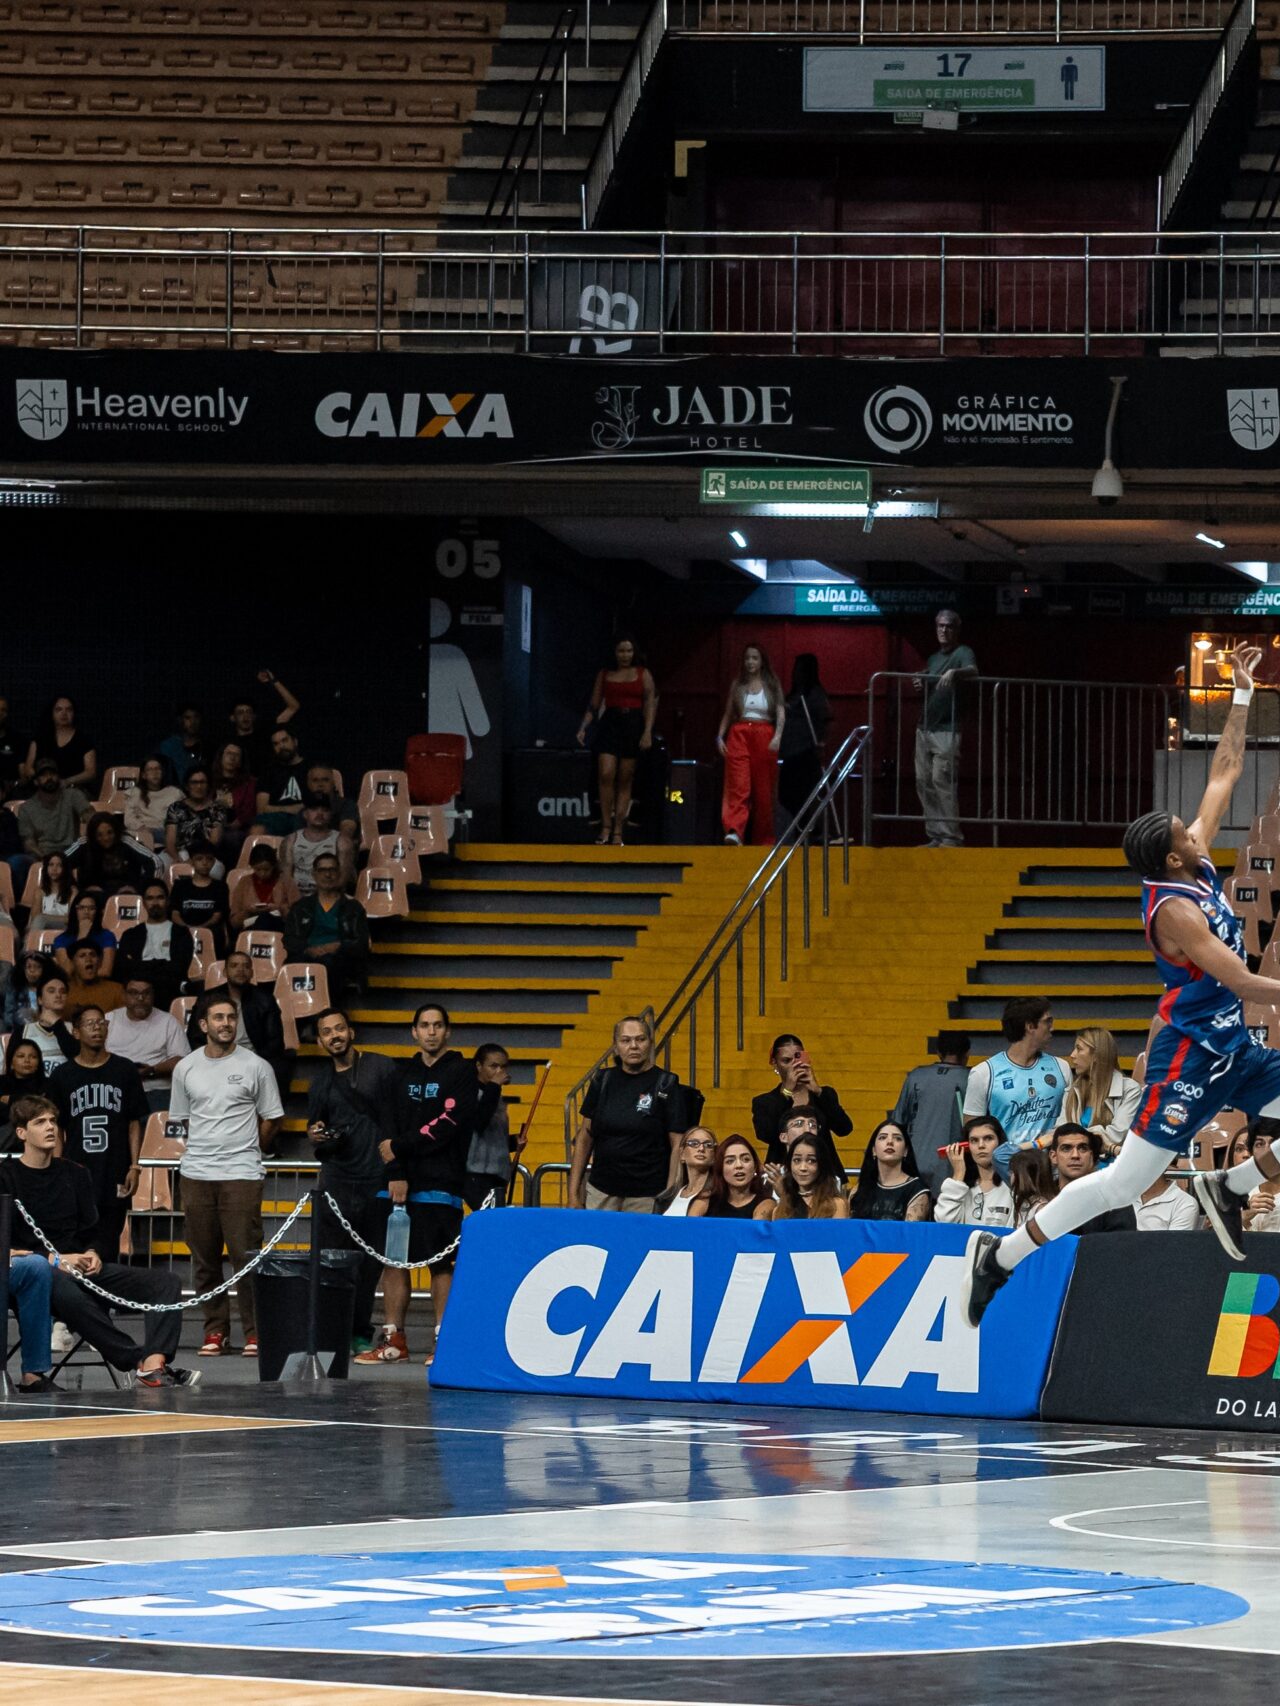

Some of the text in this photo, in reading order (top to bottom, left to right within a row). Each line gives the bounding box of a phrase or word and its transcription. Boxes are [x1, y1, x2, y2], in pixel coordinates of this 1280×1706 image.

[936, 53, 972, 77] 17
[887, 85, 1023, 99] SAÍDA DE EMERGÊNCIA
[76, 387, 248, 425] Heavenly
[652, 386, 793, 426] JADE
[958, 393, 1056, 409] GRÁFICA
[315, 391, 514, 438] CAIXA
[942, 413, 1073, 432] MOVIMENTO
[77, 422, 226, 432] INTERNATIONAL SCHOOL
[690, 437, 762, 449] HOTEL
[730, 478, 863, 490] SAÍDA DE EMERGÊNCIA
[435, 539, 501, 579] 05
[808, 587, 847, 603] SAÍDA
[850, 589, 868, 603] DE
[1187, 591, 1206, 606] DE
[1242, 607, 1269, 615] EXIT
[1240, 890, 1255, 899] J 01
[70, 1083, 123, 1117] CELTICS
[83, 1115, 108, 1153] 5
[504, 1244, 980, 1393] CAIXA
[1216, 1398, 1246, 1416] DO
[68, 1559, 809, 1617] CAIXA
[349, 1583, 1100, 1644] BRASIL
